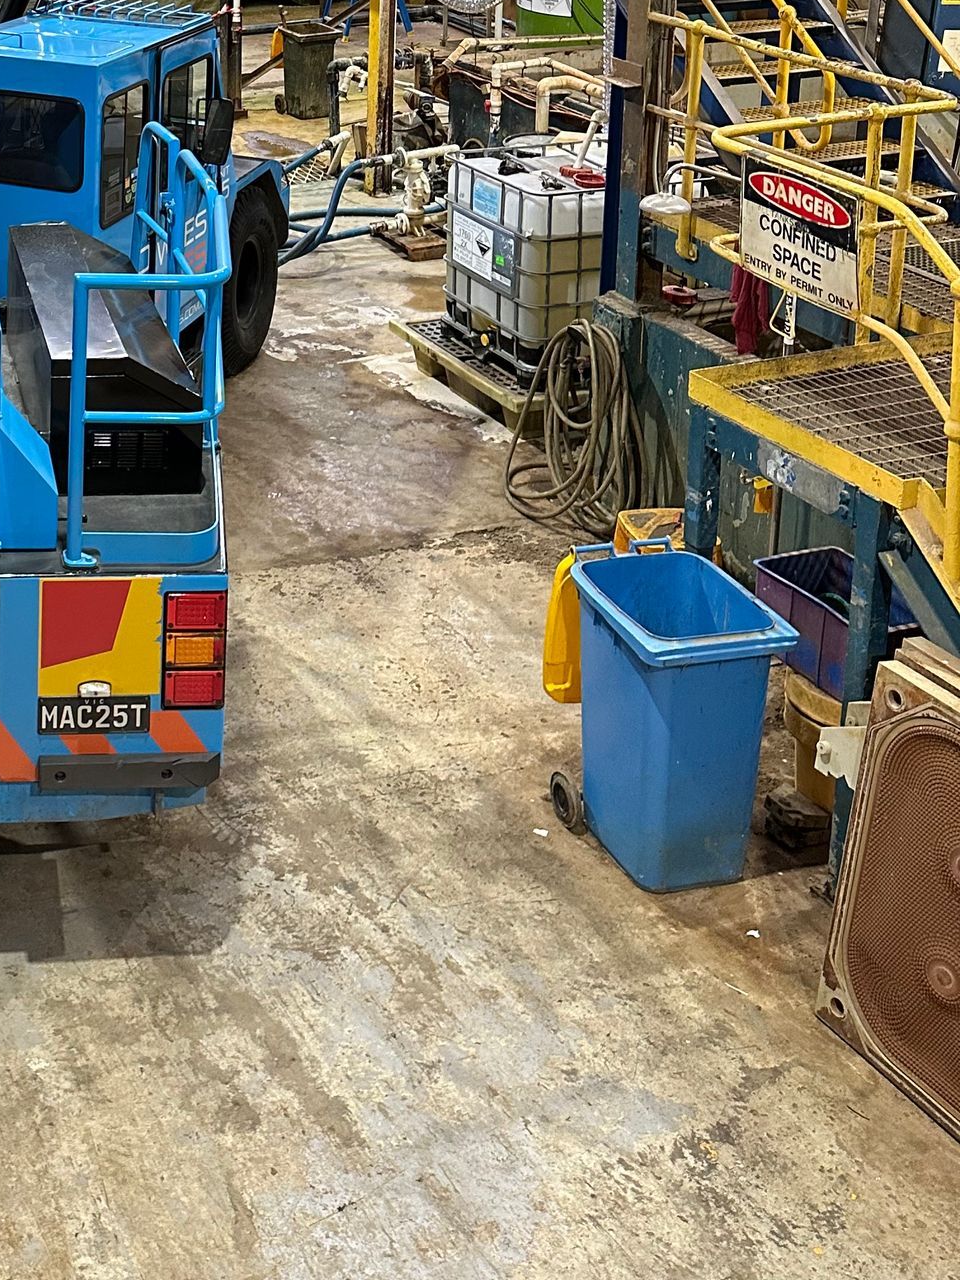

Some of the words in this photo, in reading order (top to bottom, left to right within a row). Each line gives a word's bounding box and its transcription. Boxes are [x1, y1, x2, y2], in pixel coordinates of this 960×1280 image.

[762, 176, 836, 224] DANGER
[759, 214, 837, 262] CONFINED
[744, 253, 772, 273] ENTRY
[775, 267, 787, 281] BY
[790, 275, 824, 298] PERMIT
[828, 293, 854, 312] ONLY
[772, 243, 822, 282] SPACE
[41, 704, 147, 729] MAC25T
